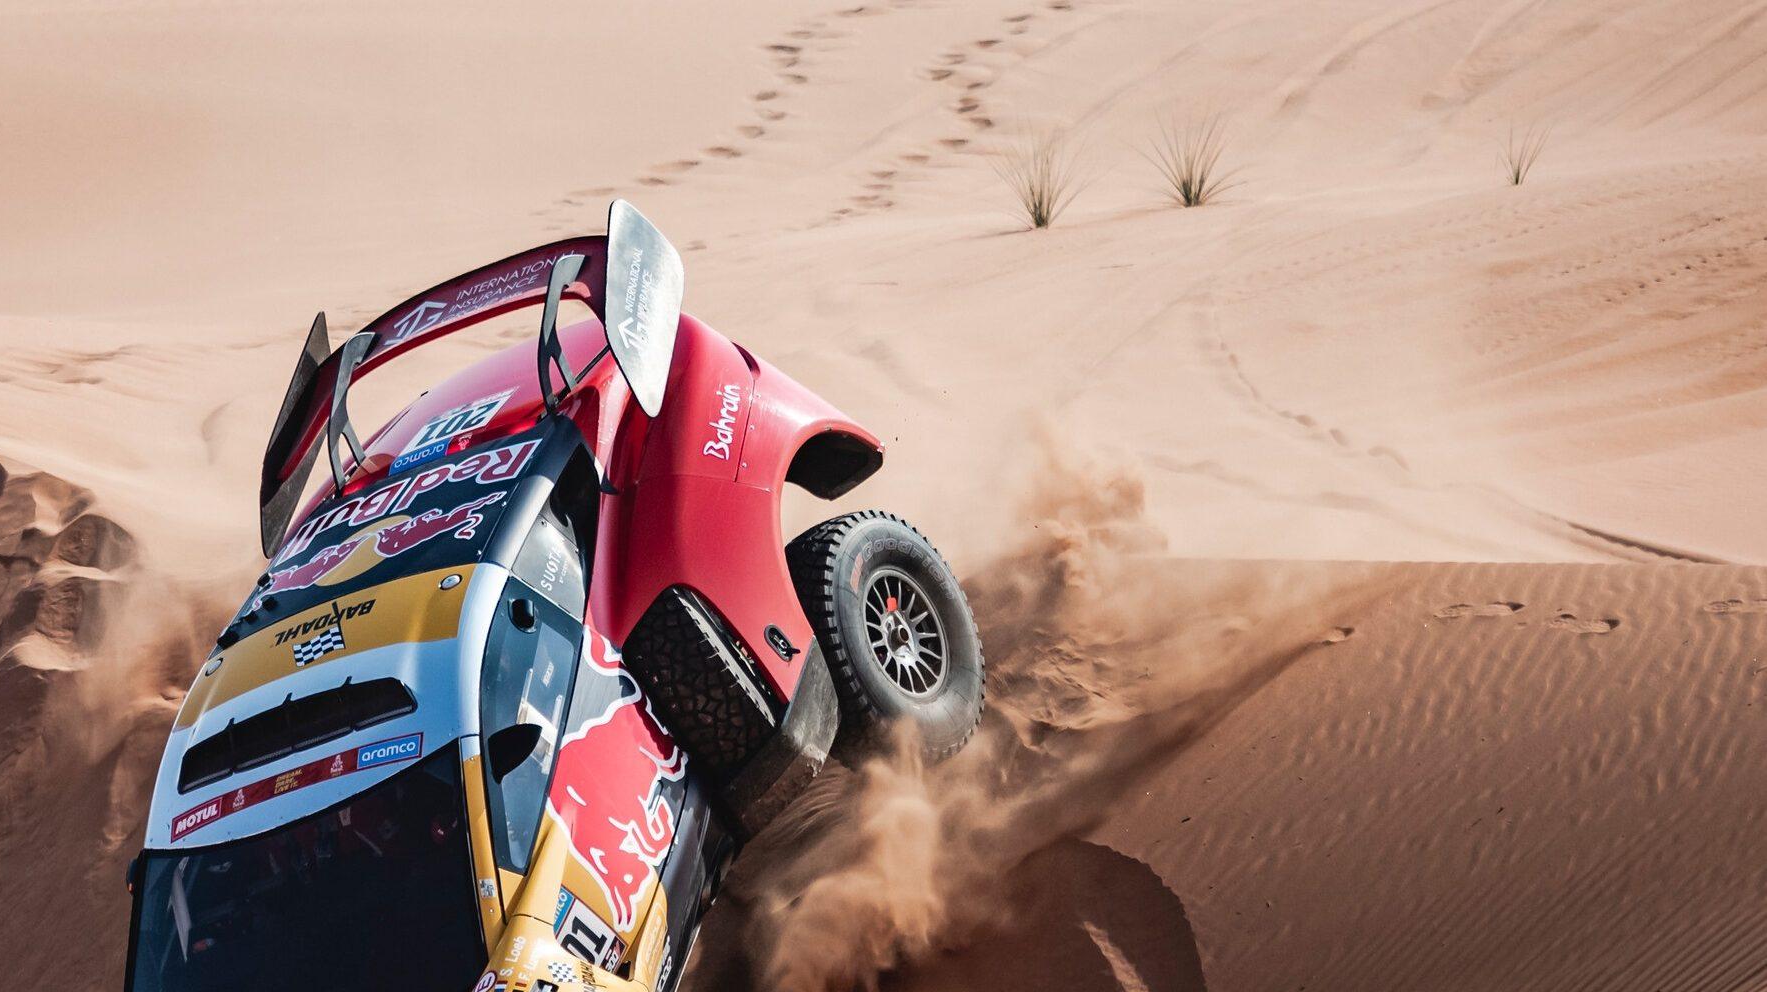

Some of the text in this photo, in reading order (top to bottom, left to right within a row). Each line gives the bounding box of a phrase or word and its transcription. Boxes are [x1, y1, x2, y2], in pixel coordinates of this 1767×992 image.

[448, 273, 541, 314] INSURANCE
[456, 250, 576, 301] INTERNATION
[624, 249, 644, 314] INTERNATIONAL
[415, 400, 500, 449] 201
[702, 384, 741, 461] Bahrain
[394, 443, 445, 469] aramco
[274, 438, 543, 567] Red Bull
[272, 599, 377, 648] BARDAHL
[361, 741, 417, 763] aramco
[175, 803, 219, 835] MOTUL
[504, 935, 527, 963] Loeb
[560, 916, 608, 966] 01
